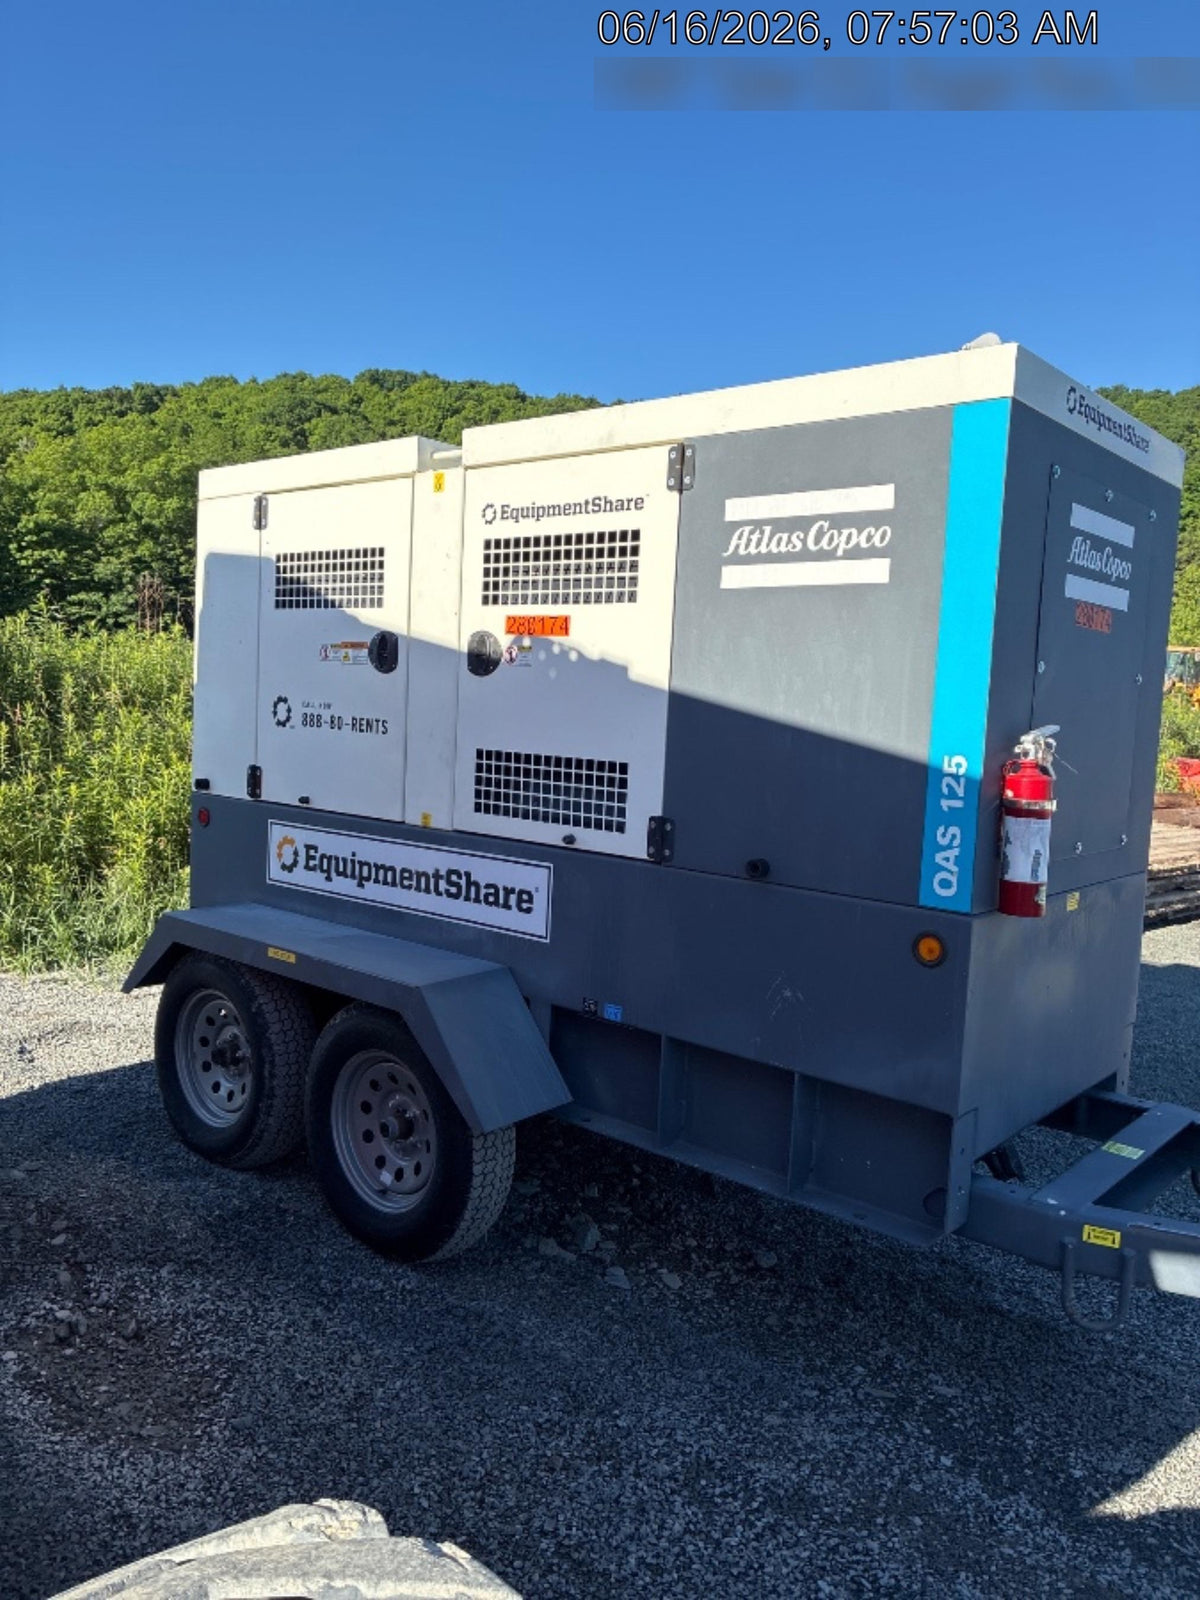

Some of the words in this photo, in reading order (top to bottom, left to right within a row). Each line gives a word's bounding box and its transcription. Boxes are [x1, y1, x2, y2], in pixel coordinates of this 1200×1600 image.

[1077, 394, 1150, 454] EquipmentShare
[500, 496, 645, 523] EquipmentShare
[721, 525, 804, 557] Atlas
[806, 520, 892, 557] Copco
[940, 754, 968, 812] 125
[303, 843, 534, 915] EquipmentShare
[933, 825, 961, 897] QAS
